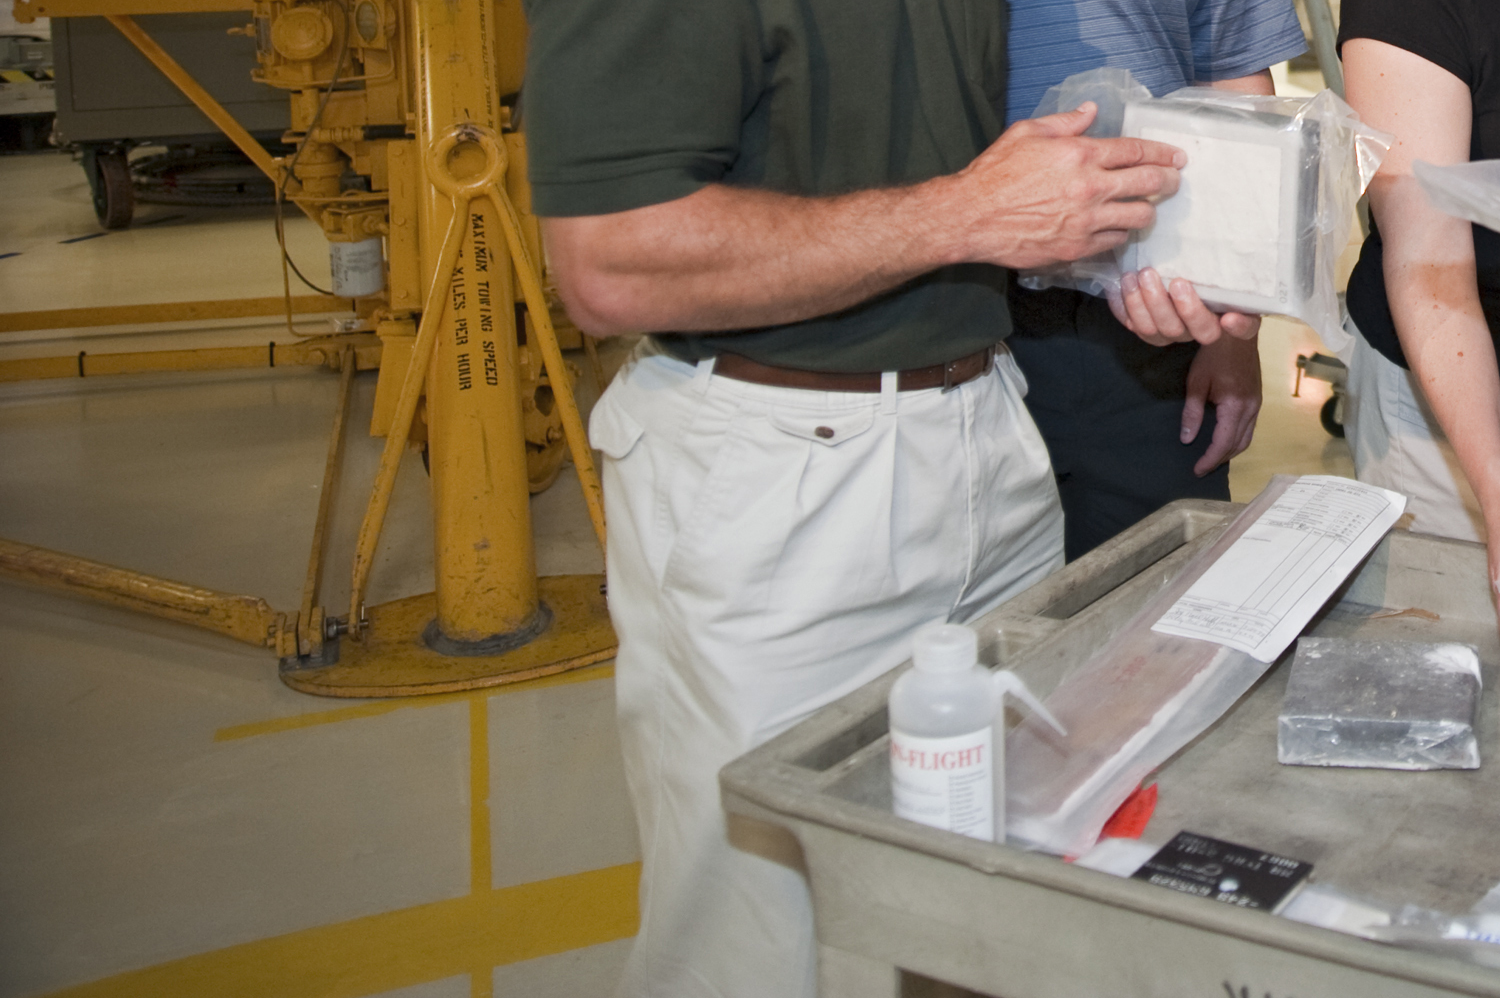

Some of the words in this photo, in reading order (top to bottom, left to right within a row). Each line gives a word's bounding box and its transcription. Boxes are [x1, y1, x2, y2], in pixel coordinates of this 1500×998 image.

[471, 213, 488, 272] MAXIMUM
[452, 267, 466, 310] MILES
[477, 281, 493, 332] TOWING
[455, 318, 469, 345] PER
[457, 353, 472, 391] HOUR
[483, 340, 498, 386] SPEED
[891, 739, 985, 771] N-FLIGHT
